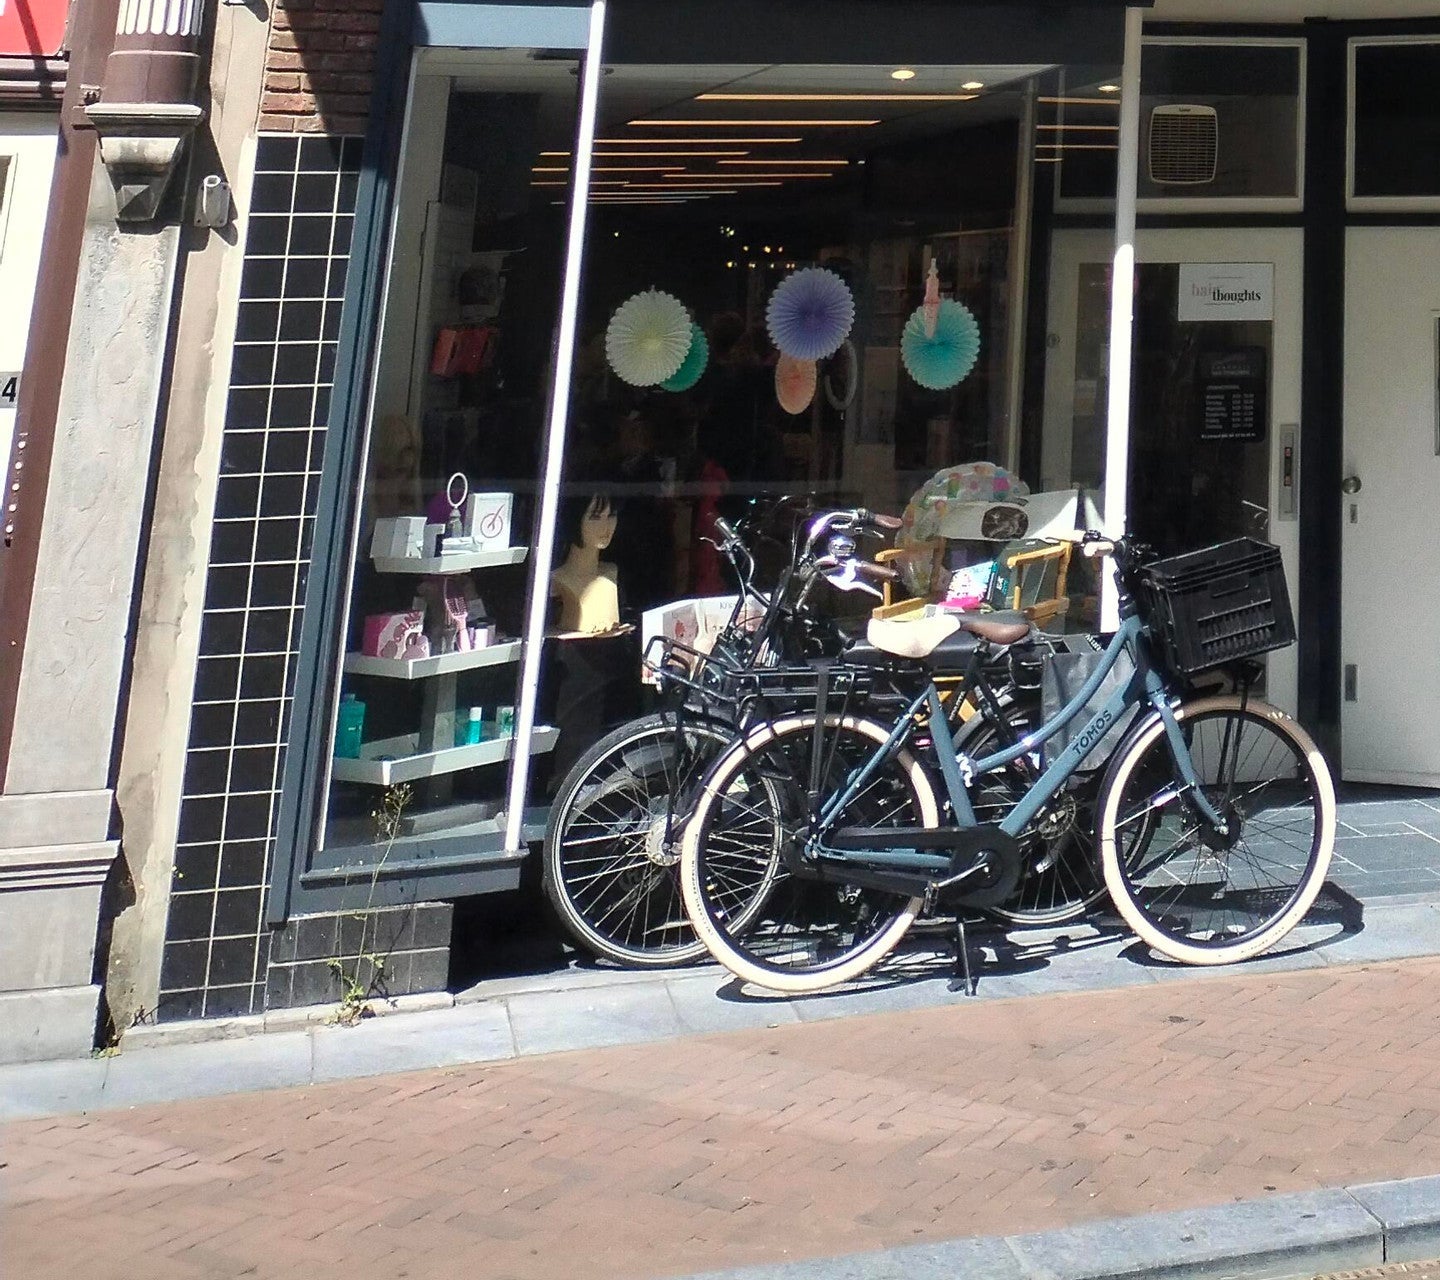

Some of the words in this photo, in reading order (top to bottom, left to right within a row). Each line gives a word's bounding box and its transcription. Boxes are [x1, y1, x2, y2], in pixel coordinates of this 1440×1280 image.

[1212, 288, 1261, 304] thoughts
[0, 376, 18, 403] 4
[1072, 709, 1113, 756] TOMOS
